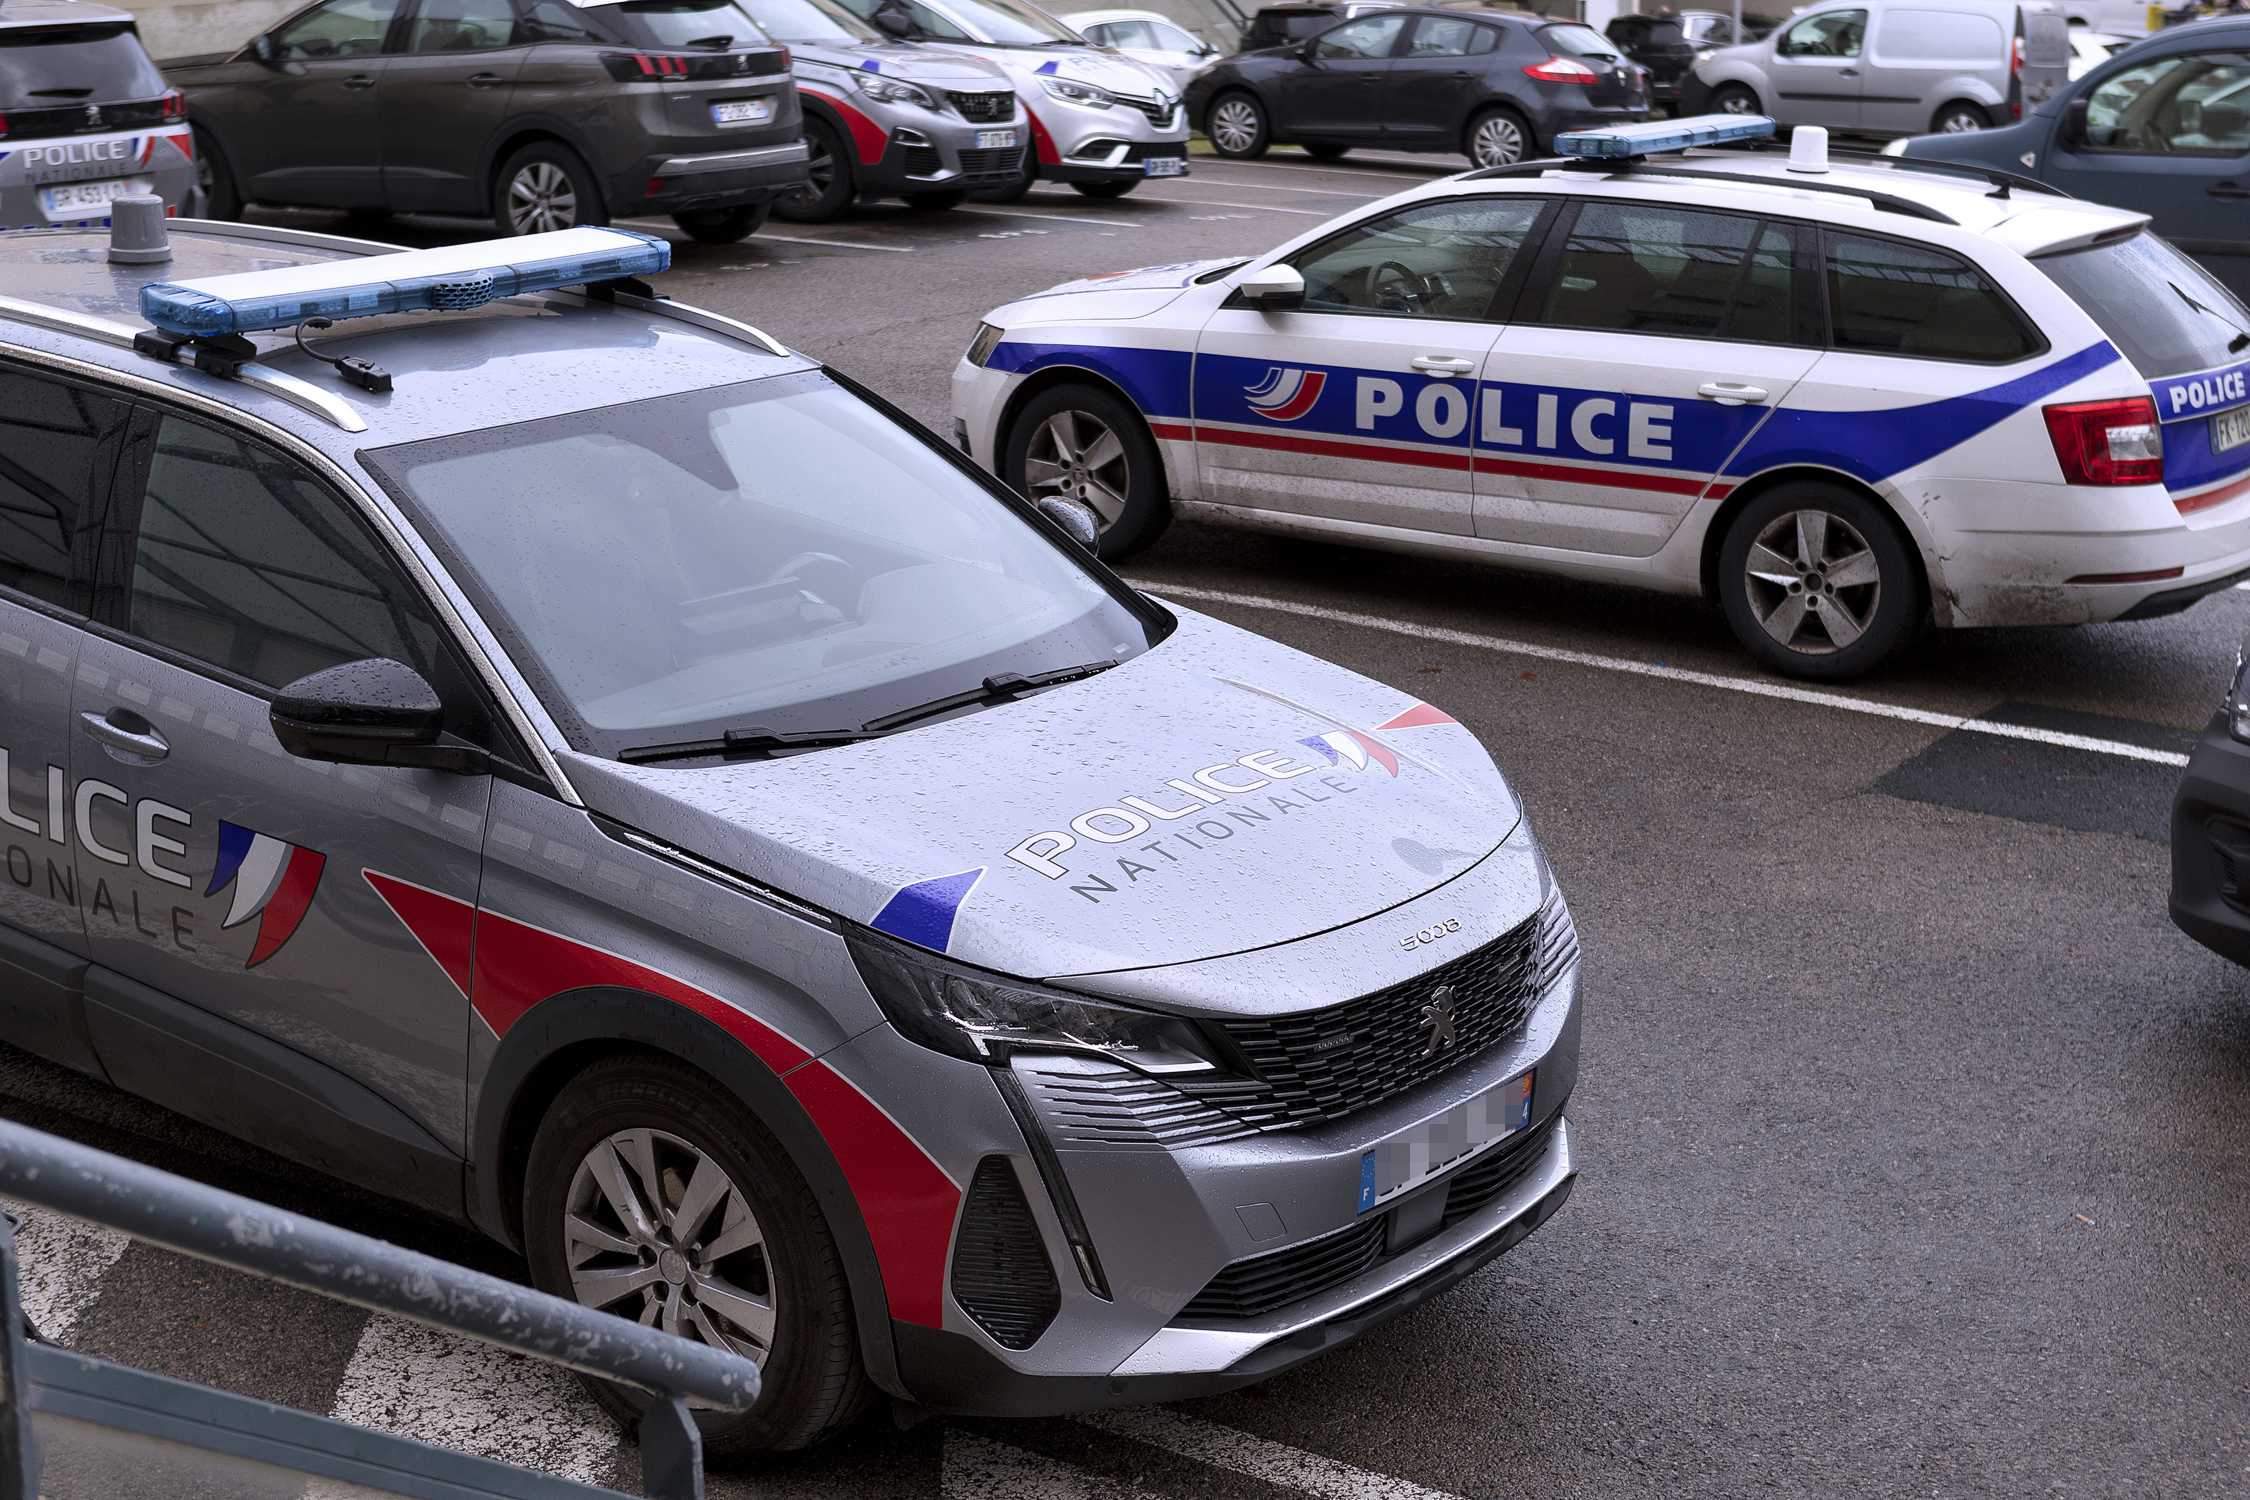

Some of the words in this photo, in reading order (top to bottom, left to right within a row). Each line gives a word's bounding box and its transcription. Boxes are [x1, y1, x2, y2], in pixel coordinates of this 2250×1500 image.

[22, 140, 127, 169] POLICE
[24, 162, 128, 184] NATIONALE
[1355, 375, 1674, 462] POLICE
[2168, 371, 2246, 413] POLICE
[0, 746, 192, 891] LICE
[1004, 748, 1317, 881] POLICE
[1069, 774, 1358, 904] NATIONALE
[6, 844, 197, 953] ONALE
[1400, 917, 1462, 951] 5008
[1362, 1187, 1370, 1201] F
